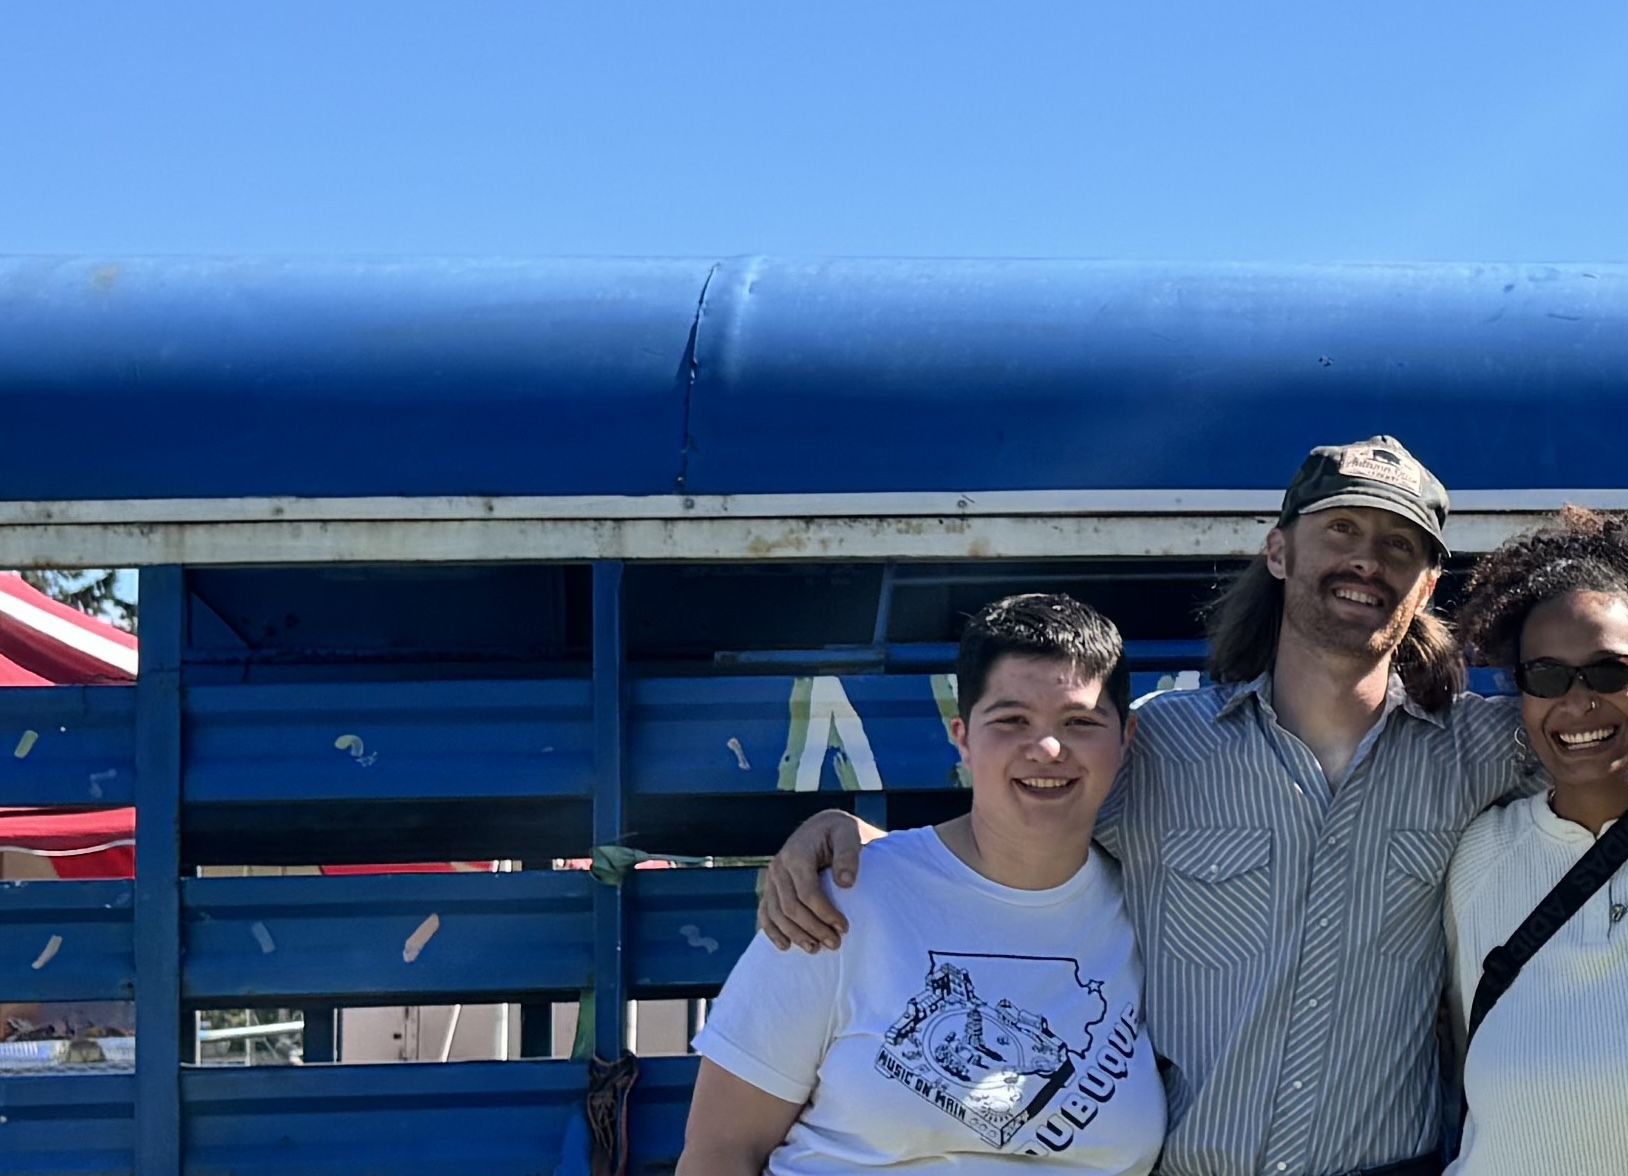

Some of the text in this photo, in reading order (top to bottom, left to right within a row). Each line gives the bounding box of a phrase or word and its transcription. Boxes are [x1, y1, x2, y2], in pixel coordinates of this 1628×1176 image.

[878, 1049, 967, 1121] MUSIC ON MAIN
